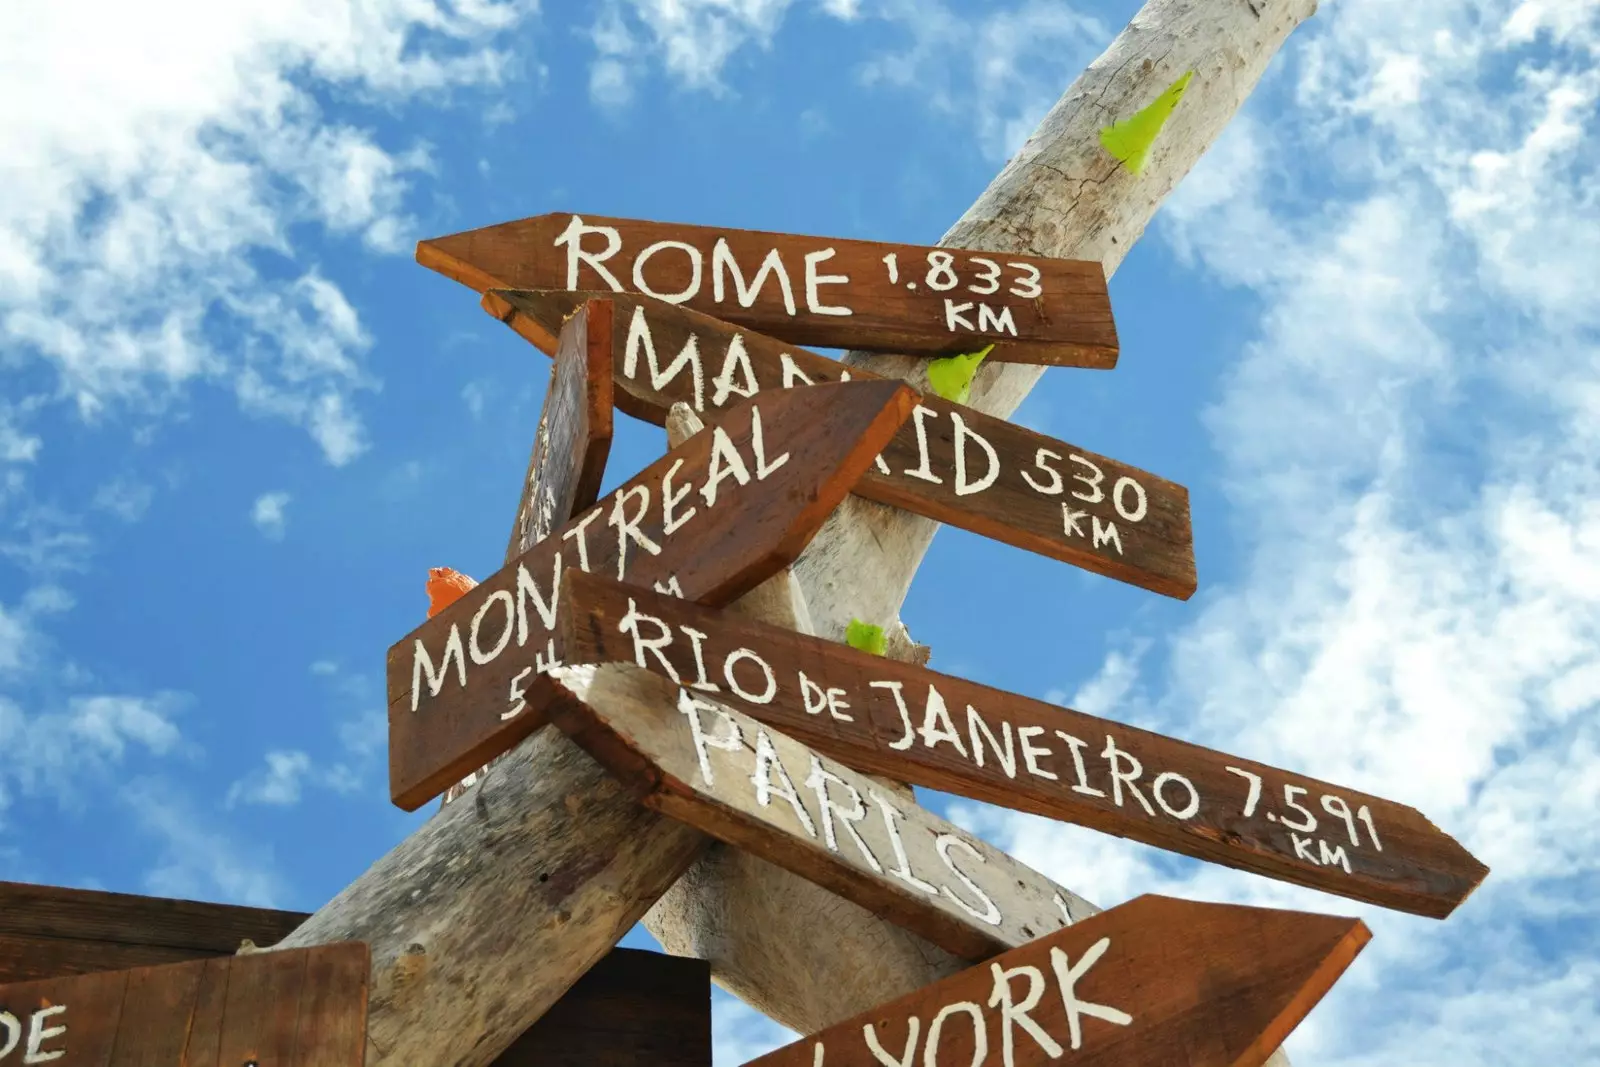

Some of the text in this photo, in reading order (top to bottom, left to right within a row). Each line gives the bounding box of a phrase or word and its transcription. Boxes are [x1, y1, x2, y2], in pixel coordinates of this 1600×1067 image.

[553, 214, 1042, 317] ROME 1.833
[944, 298, 1018, 336] KM
[623, 305, 1000, 496] MAID
[1020, 448, 1148, 522] 530
[410, 404, 790, 711] MONTREAL
[1060, 502, 1123, 555] KM
[618, 597, 1382, 852] RIO DE JANEIRO 7.591
[677, 688, 1002, 926] PARIS
[1291, 832, 1353, 875] KM
